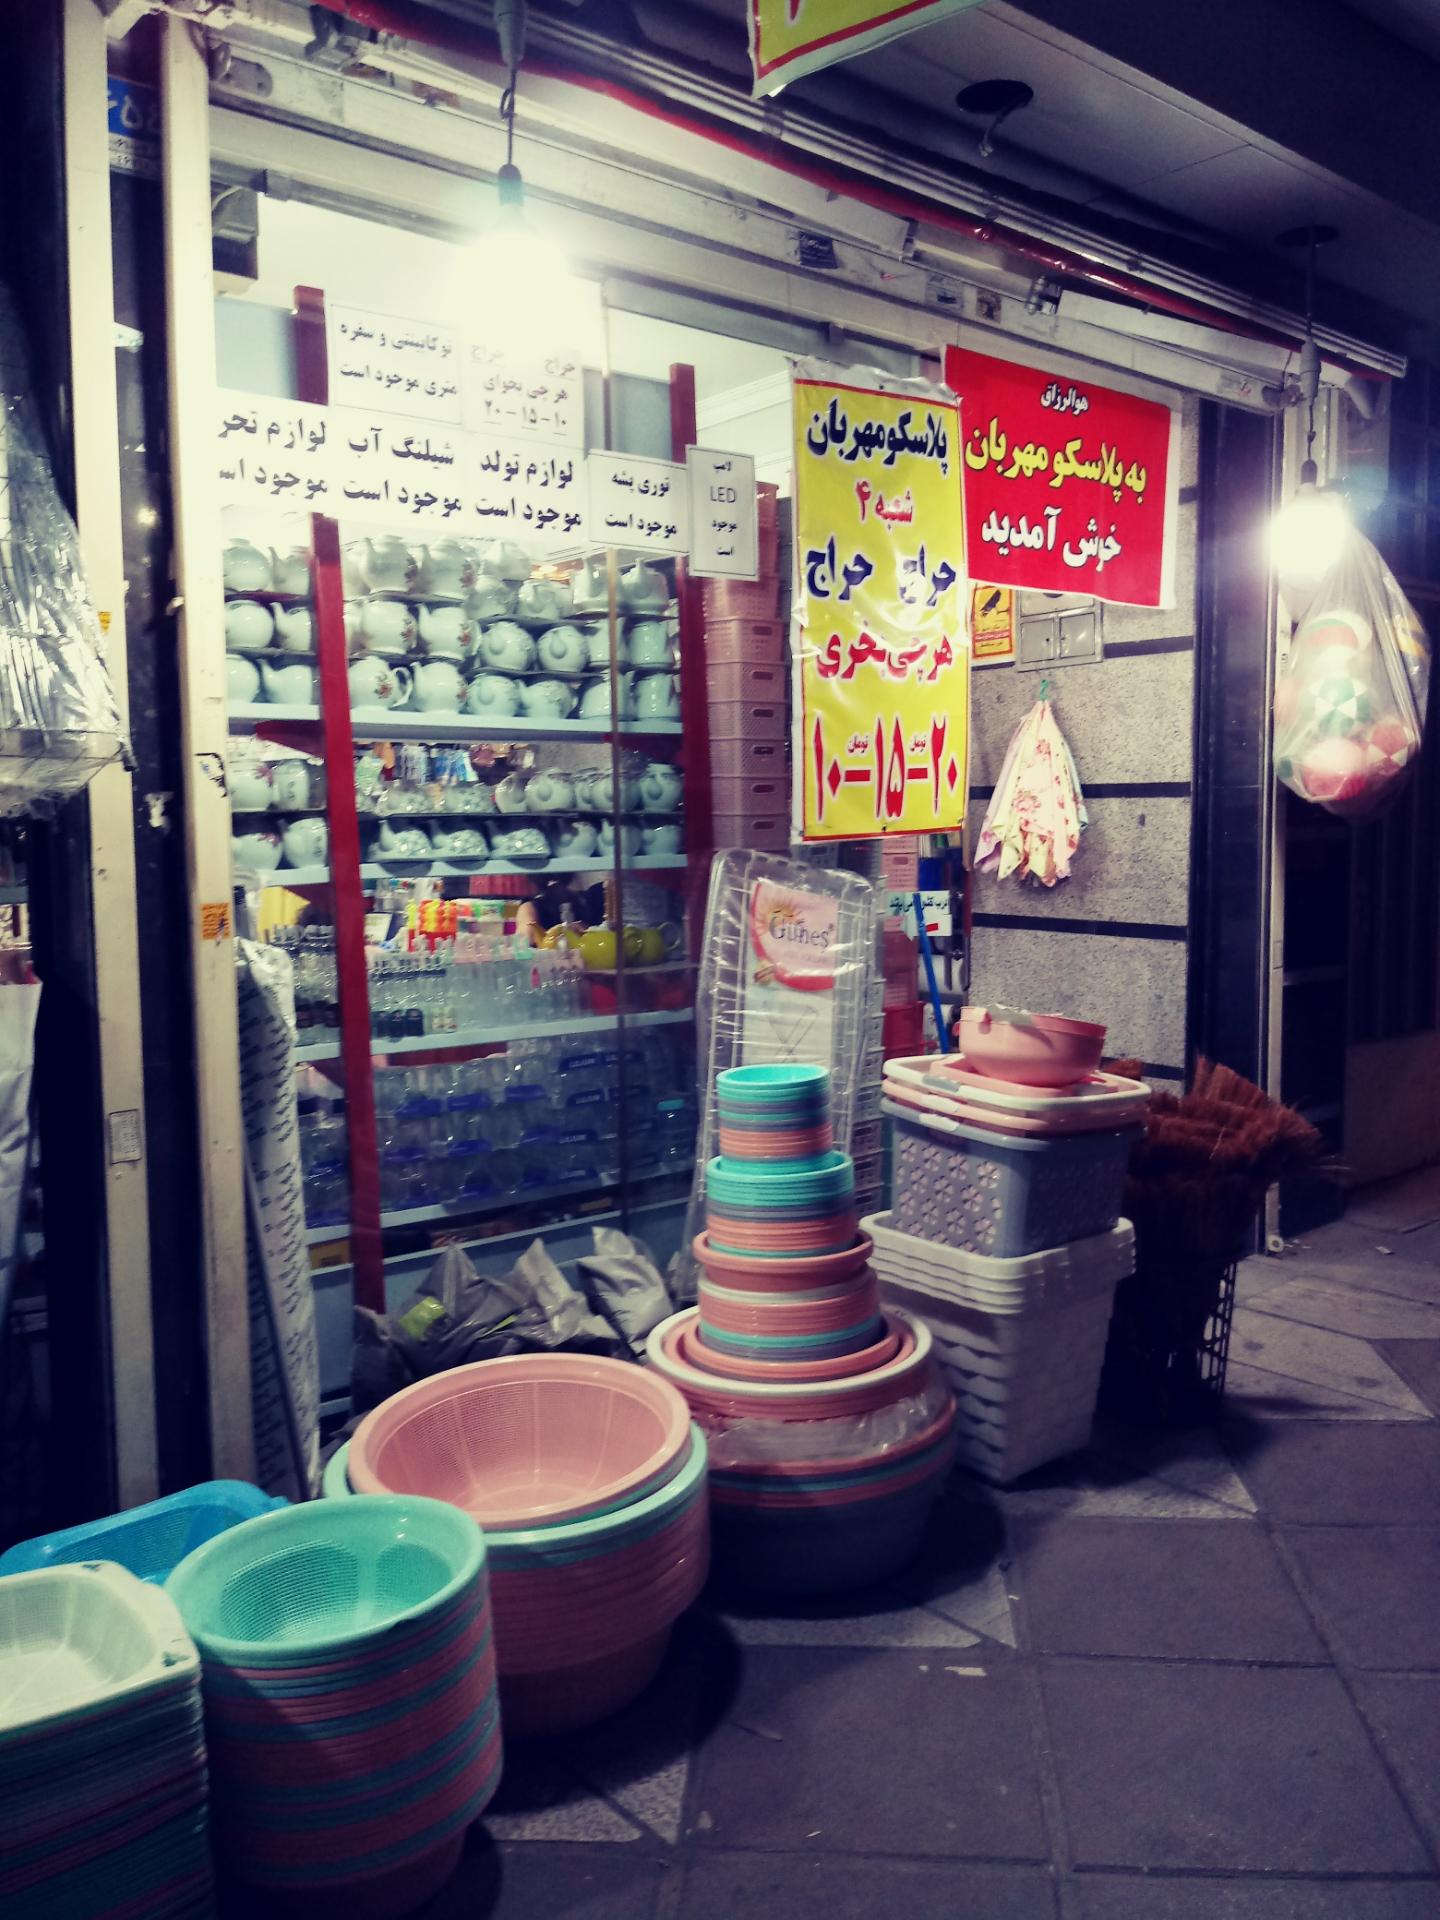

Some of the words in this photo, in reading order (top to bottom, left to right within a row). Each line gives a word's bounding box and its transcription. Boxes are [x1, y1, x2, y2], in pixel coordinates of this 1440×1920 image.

[340, 363, 370, 379] است
[376, 369, 420, 393] موجود
[218, 410, 257, 438] تحر
[267, 418, 326, 452] لوازم
[349, 427, 383, 459] آب
[391, 436, 454, 470] شیلنگ
[965, 416, 1049, 479] مهربان
[219, 457, 245, 481] اس
[480, 449, 520, 482] تولد
[526, 458, 574, 489] لوازم
[1049, 439, 1124, 504] پلاسکو
[254, 466, 328, 500] موجود
[343, 480, 388, 500] است
[637, 475, 671, 497] توری
[710, 486, 737, 504] LED
[1124, 462, 1147, 504] به
[397, 486, 462, 518] موجود
[476, 496, 516, 516] است
[523, 503, 582, 532] موجود
[605, 513, 633, 529] است
[637, 517, 677, 539] موجود
[712, 519, 737, 533] موجود
[981, 505, 1063, 556] آمدید
[716, 546, 734, 557] است
[1062, 518, 1122, 572] خوش
[806, 535, 874, 601] حراج
